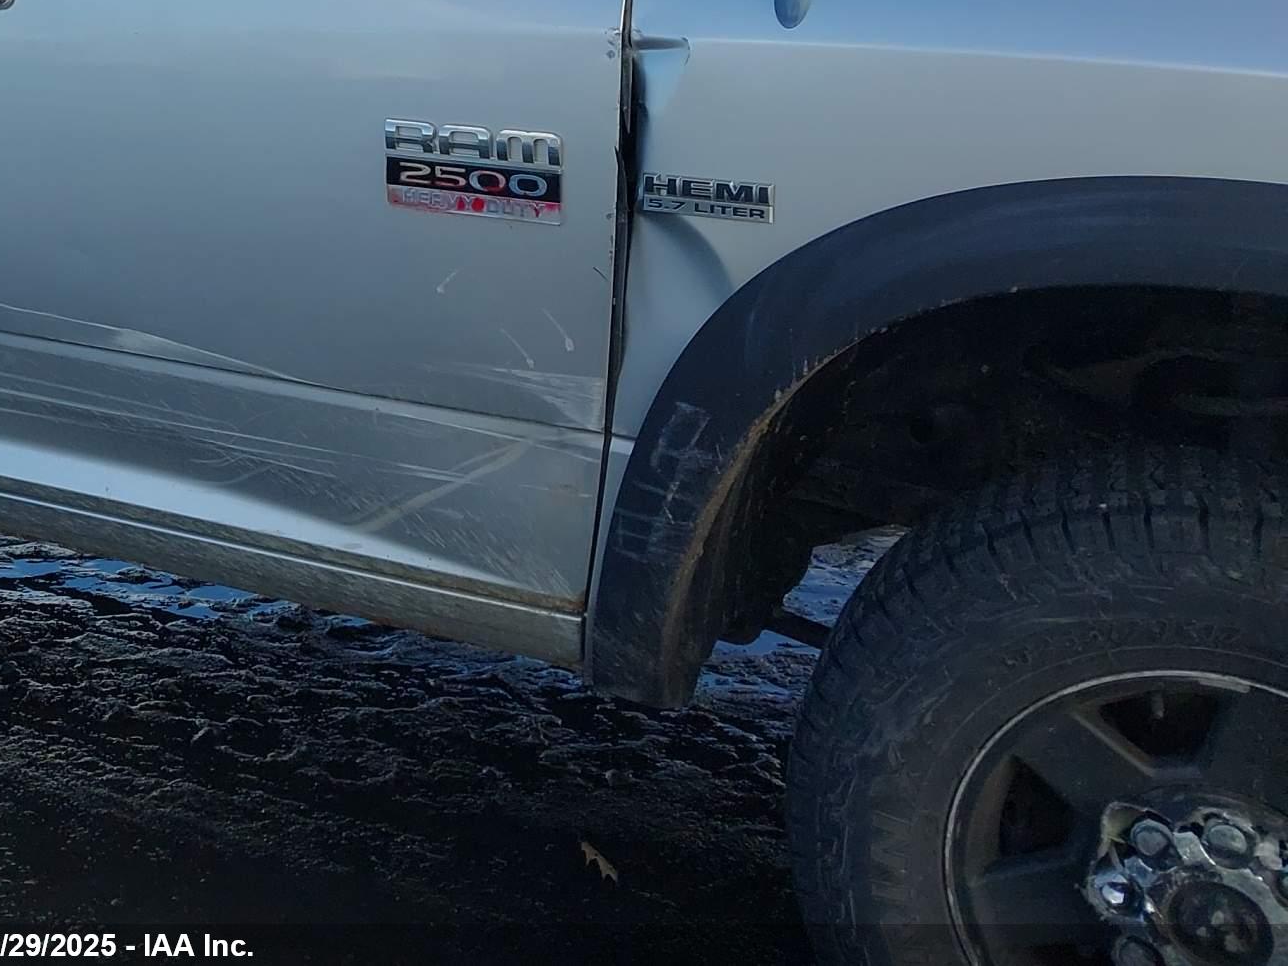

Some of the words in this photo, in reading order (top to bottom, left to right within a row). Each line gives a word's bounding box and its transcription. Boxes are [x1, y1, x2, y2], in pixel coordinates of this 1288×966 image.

[384, 119, 562, 165] RAM
[400, 163, 548, 197] 2500
[644, 173, 774, 204] HEMI
[402, 188, 475, 211] HEAVY
[486, 198, 546, 218] DUTY
[648, 198, 686, 210] 5.7
[694, 203, 766, 219] LITER
